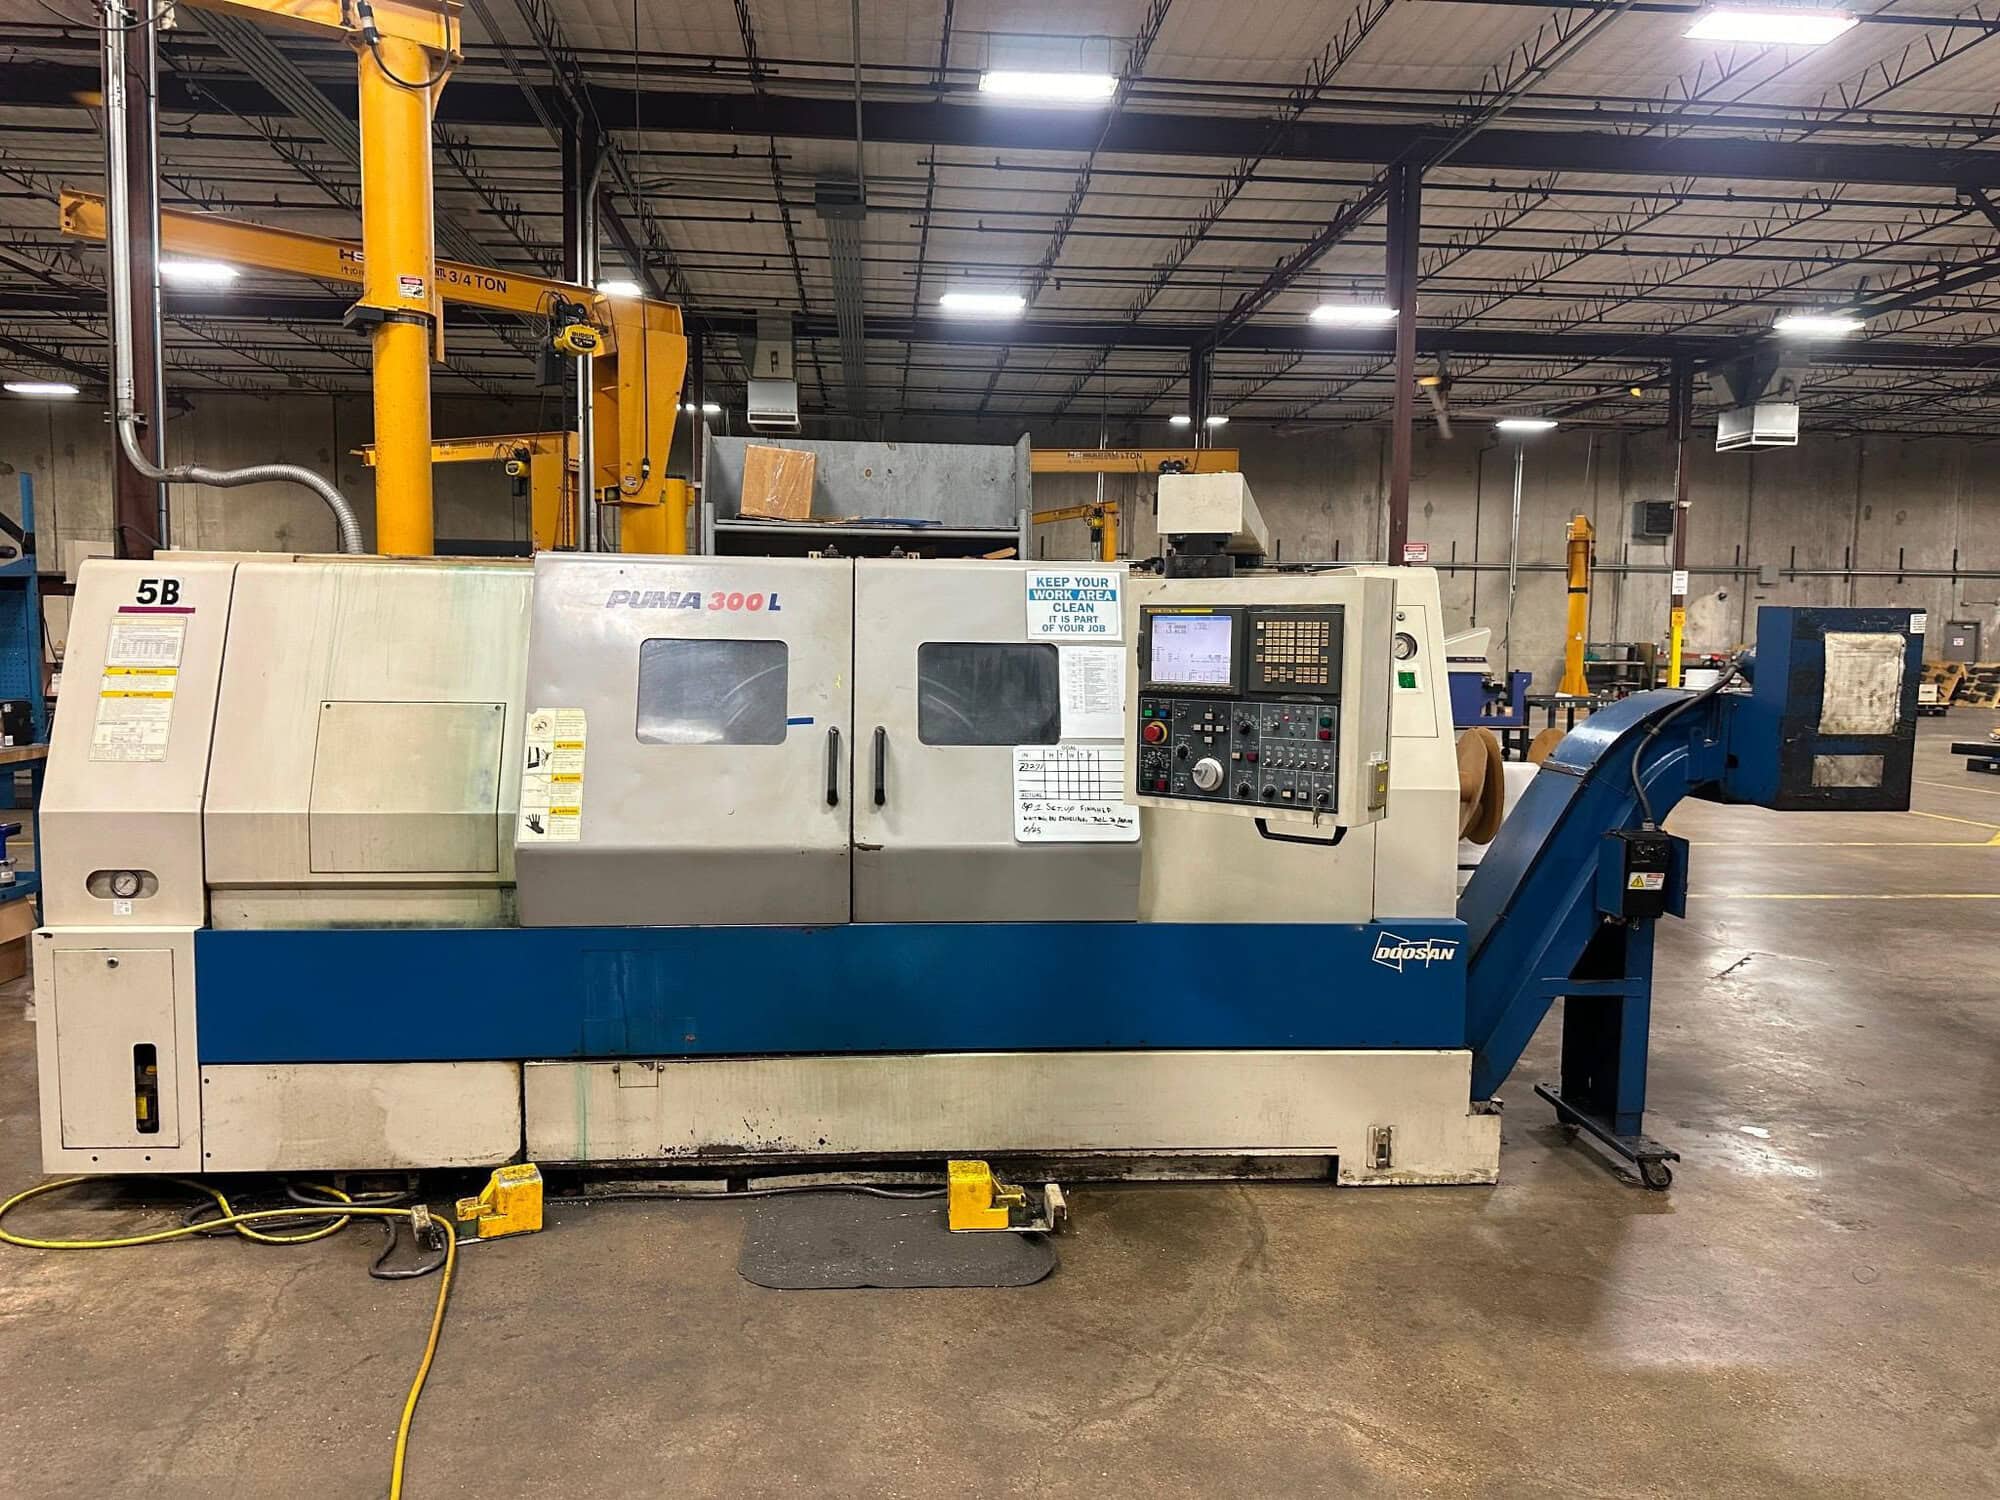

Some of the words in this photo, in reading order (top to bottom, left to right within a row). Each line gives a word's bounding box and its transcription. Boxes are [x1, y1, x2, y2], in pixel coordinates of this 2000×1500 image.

[449, 271, 471, 287] 3/4
[475, 277, 507, 293] TON
[1036, 577, 1070, 587] KEEP
[1075, 577, 1109, 588] YOUR
[136, 579, 180, 605] 5B
[1033, 589, 1073, 600] WORK
[1077, 590, 1113, 601] AREA
[606, 590, 701, 609] PUMA
[1053, 602, 1094, 613] CLEAN
[1049, 615, 1057, 623] IT
[1061, 615, 1070, 623] IS
[1074, 615, 1098, 623] PART
[1042, 624, 1055, 632] OF
[1058, 624, 1084, 632] YOUR
[1088, 624, 1106, 632] JOB
[1376, 947, 1455, 960] DOOSAN
